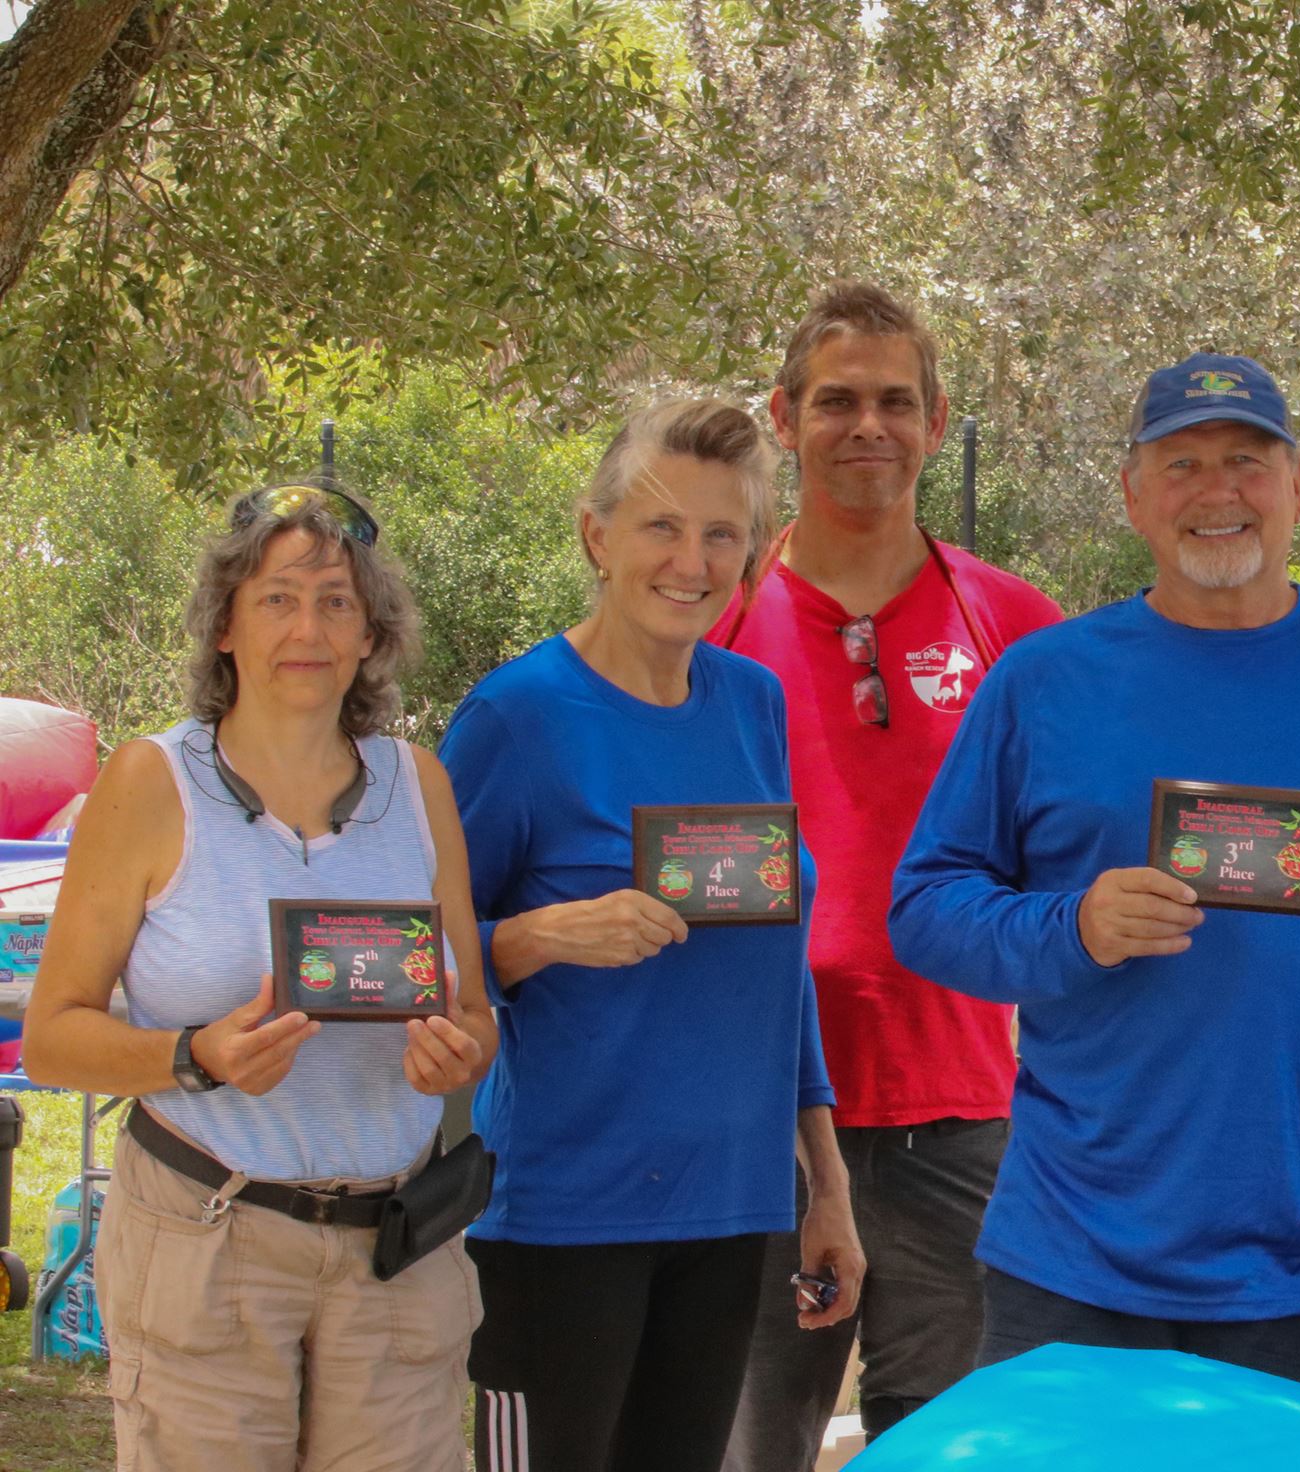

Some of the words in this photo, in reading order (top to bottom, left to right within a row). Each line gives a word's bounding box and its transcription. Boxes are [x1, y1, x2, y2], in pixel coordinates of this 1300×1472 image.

[906, 652, 921, 660] BIG
[1223, 840, 1254, 864] 3rd
[709, 857, 736, 882] 4th
[1219, 866, 1255, 880] Place
[706, 885, 740, 897] Place
[352, 950, 379, 976] 5th
[350, 977, 385, 990] Place
